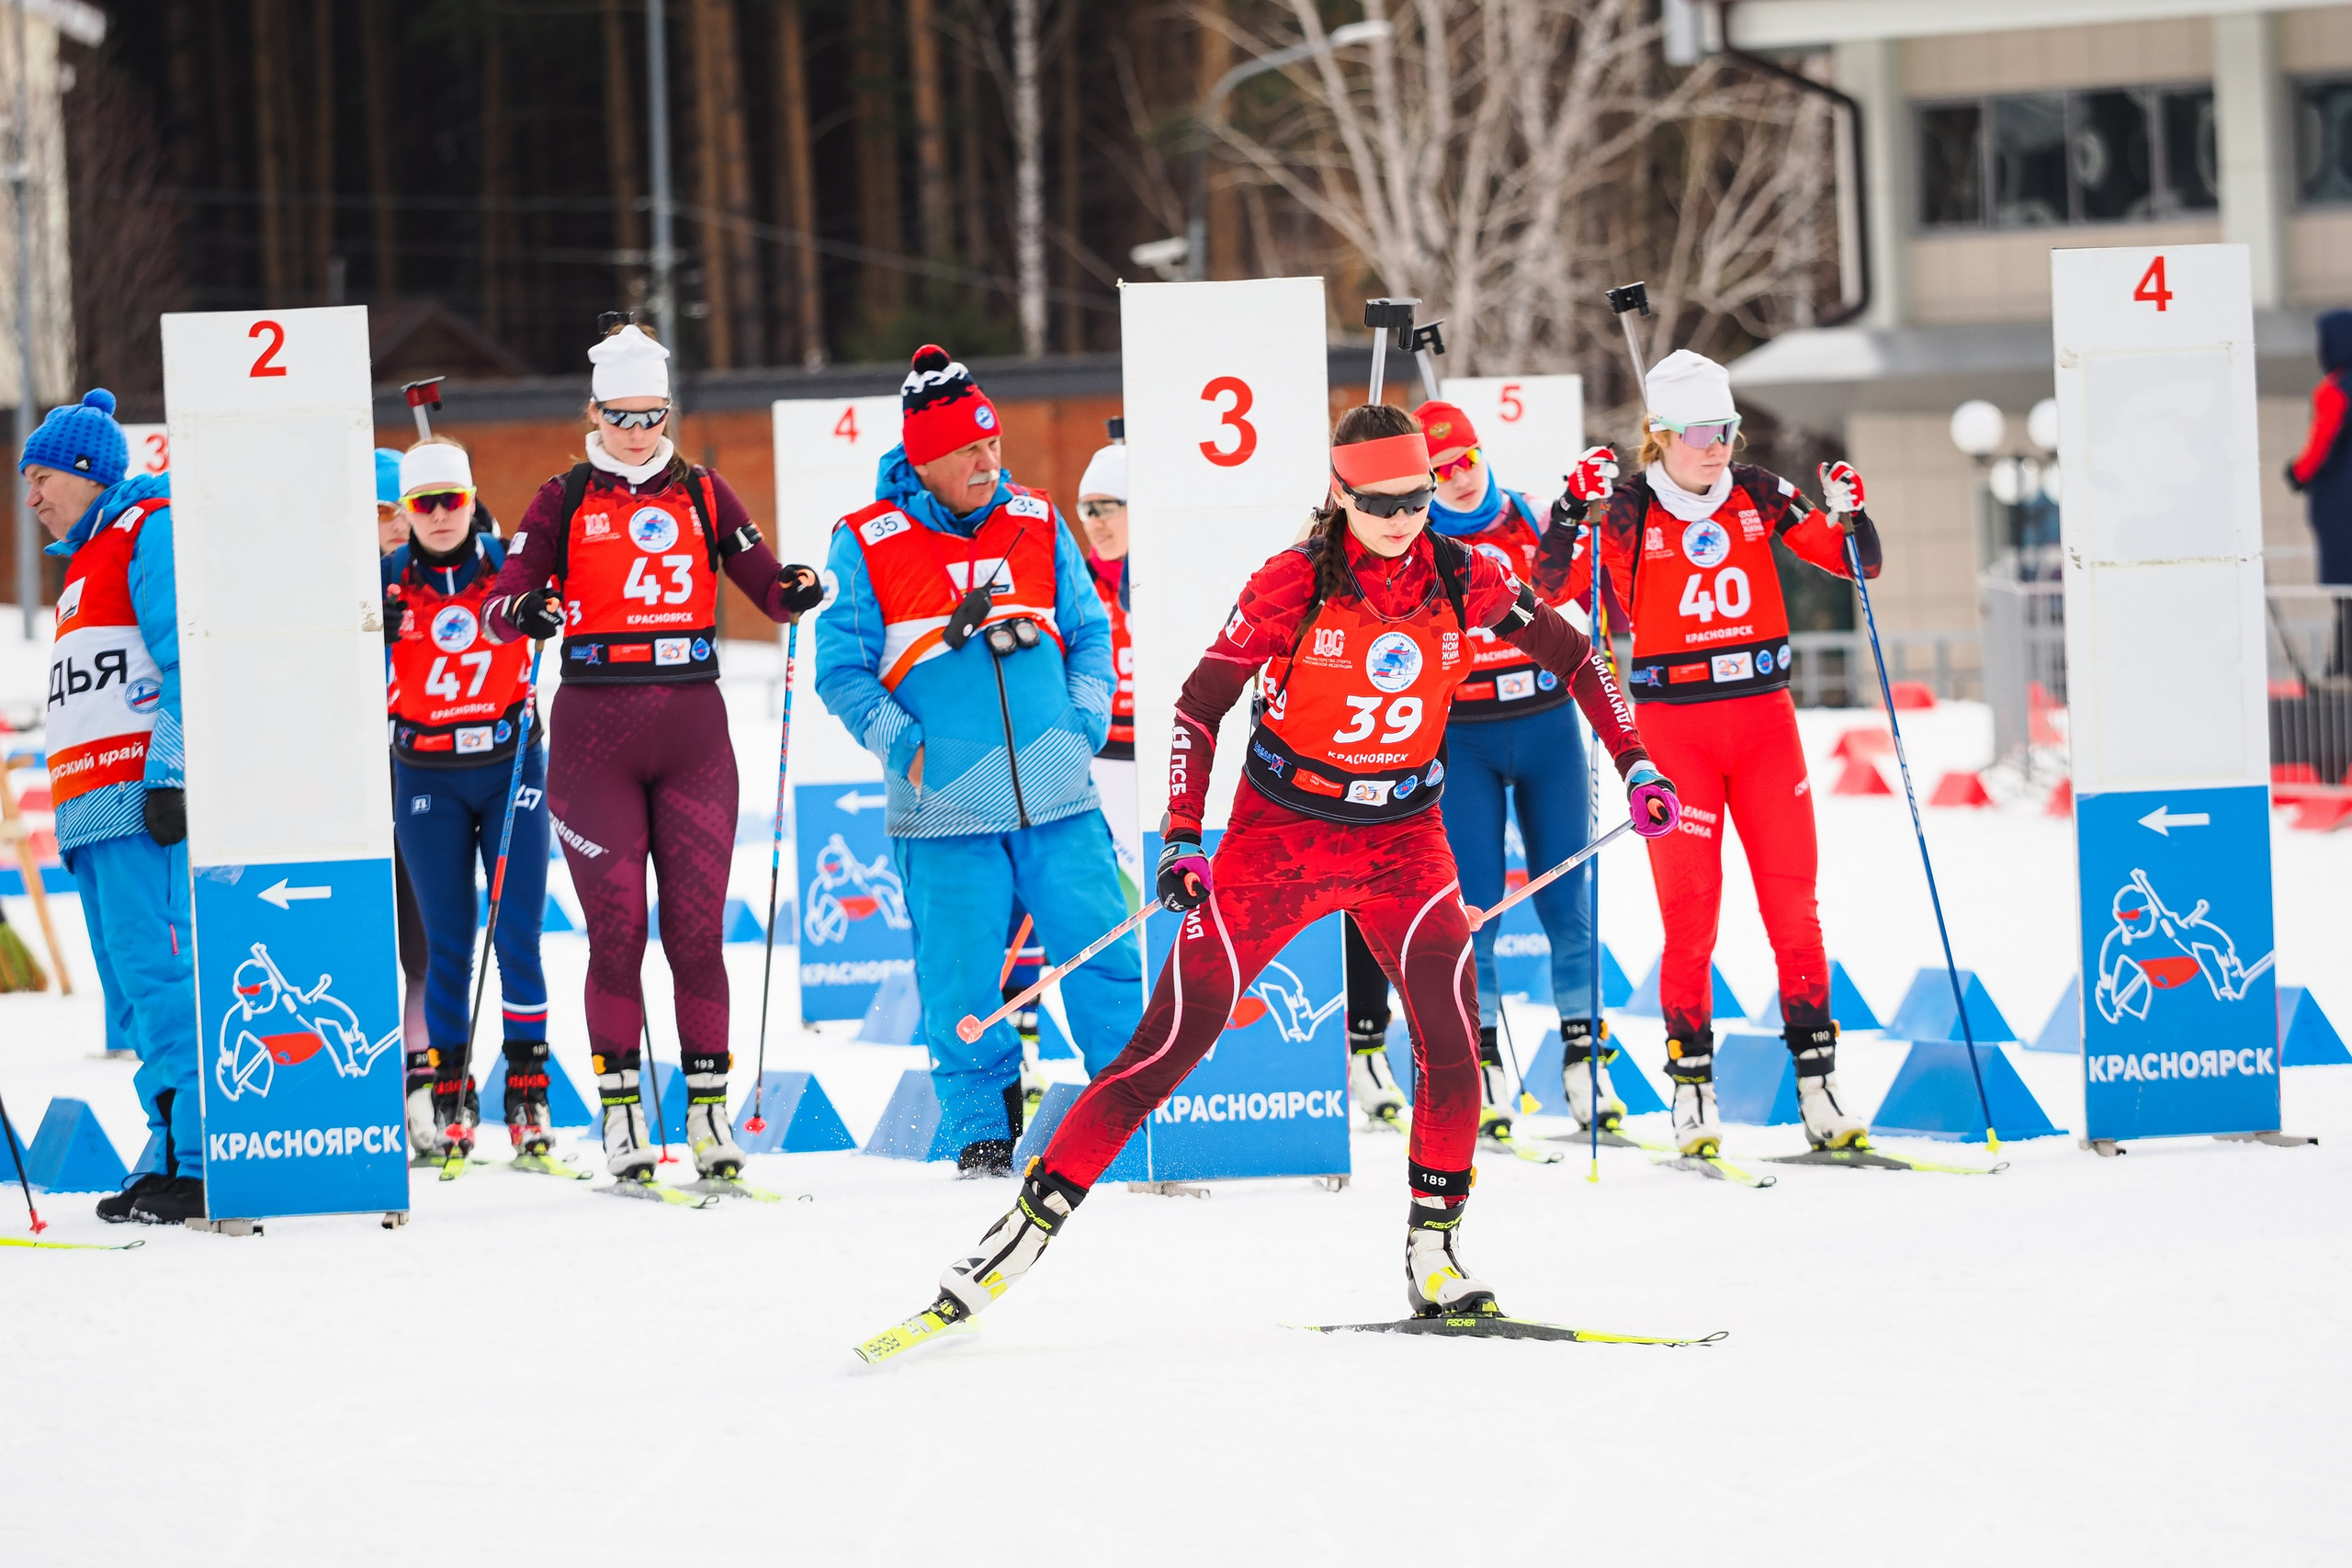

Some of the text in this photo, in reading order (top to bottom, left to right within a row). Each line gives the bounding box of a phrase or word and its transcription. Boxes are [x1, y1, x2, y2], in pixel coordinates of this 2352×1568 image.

[2133, 255, 2173, 311] 4
[249, 321, 287, 378] 2
[1199, 377, 1258, 467] 3
[1498, 384, 1524, 423] 5
[833, 405, 860, 444] 4
[144, 432, 169, 473] 3
[871, 514, 899, 539] 35
[623, 554, 694, 606] 43
[1679, 567, 1751, 623] 40
[627, 612, 694, 626] КРАСНОЯРСК
[1685, 625, 1754, 644] КРАСНОЯРСК
[425, 649, 493, 702] 47
[1590, 654, 1633, 733] УДМУРТИЯ
[431, 702, 496, 721] КРАСНОЯРСК
[1332, 694, 1423, 744] 39
[98, 741, 144, 768] край
[1327, 750, 1409, 765] КРАСНОЯРСК
[1171, 754, 1187, 796] ПСБ
[1811, 1031, 1830, 1043] 190
[694, 1058, 715, 1070] 193
[2088, 1046, 2276, 1083] КРАСНОЯРСК
[1155, 1089, 1344, 1124] КРАСНОЯРСК
[209, 1123, 402, 1161] КРАСНОЯРСК
[1421, 1173, 1447, 1187] 189
[1019, 1195, 1053, 1231] FISCHER
[1423, 1213, 1464, 1229] FISCHE
[1445, 1318, 1476, 1327] FISCHER
